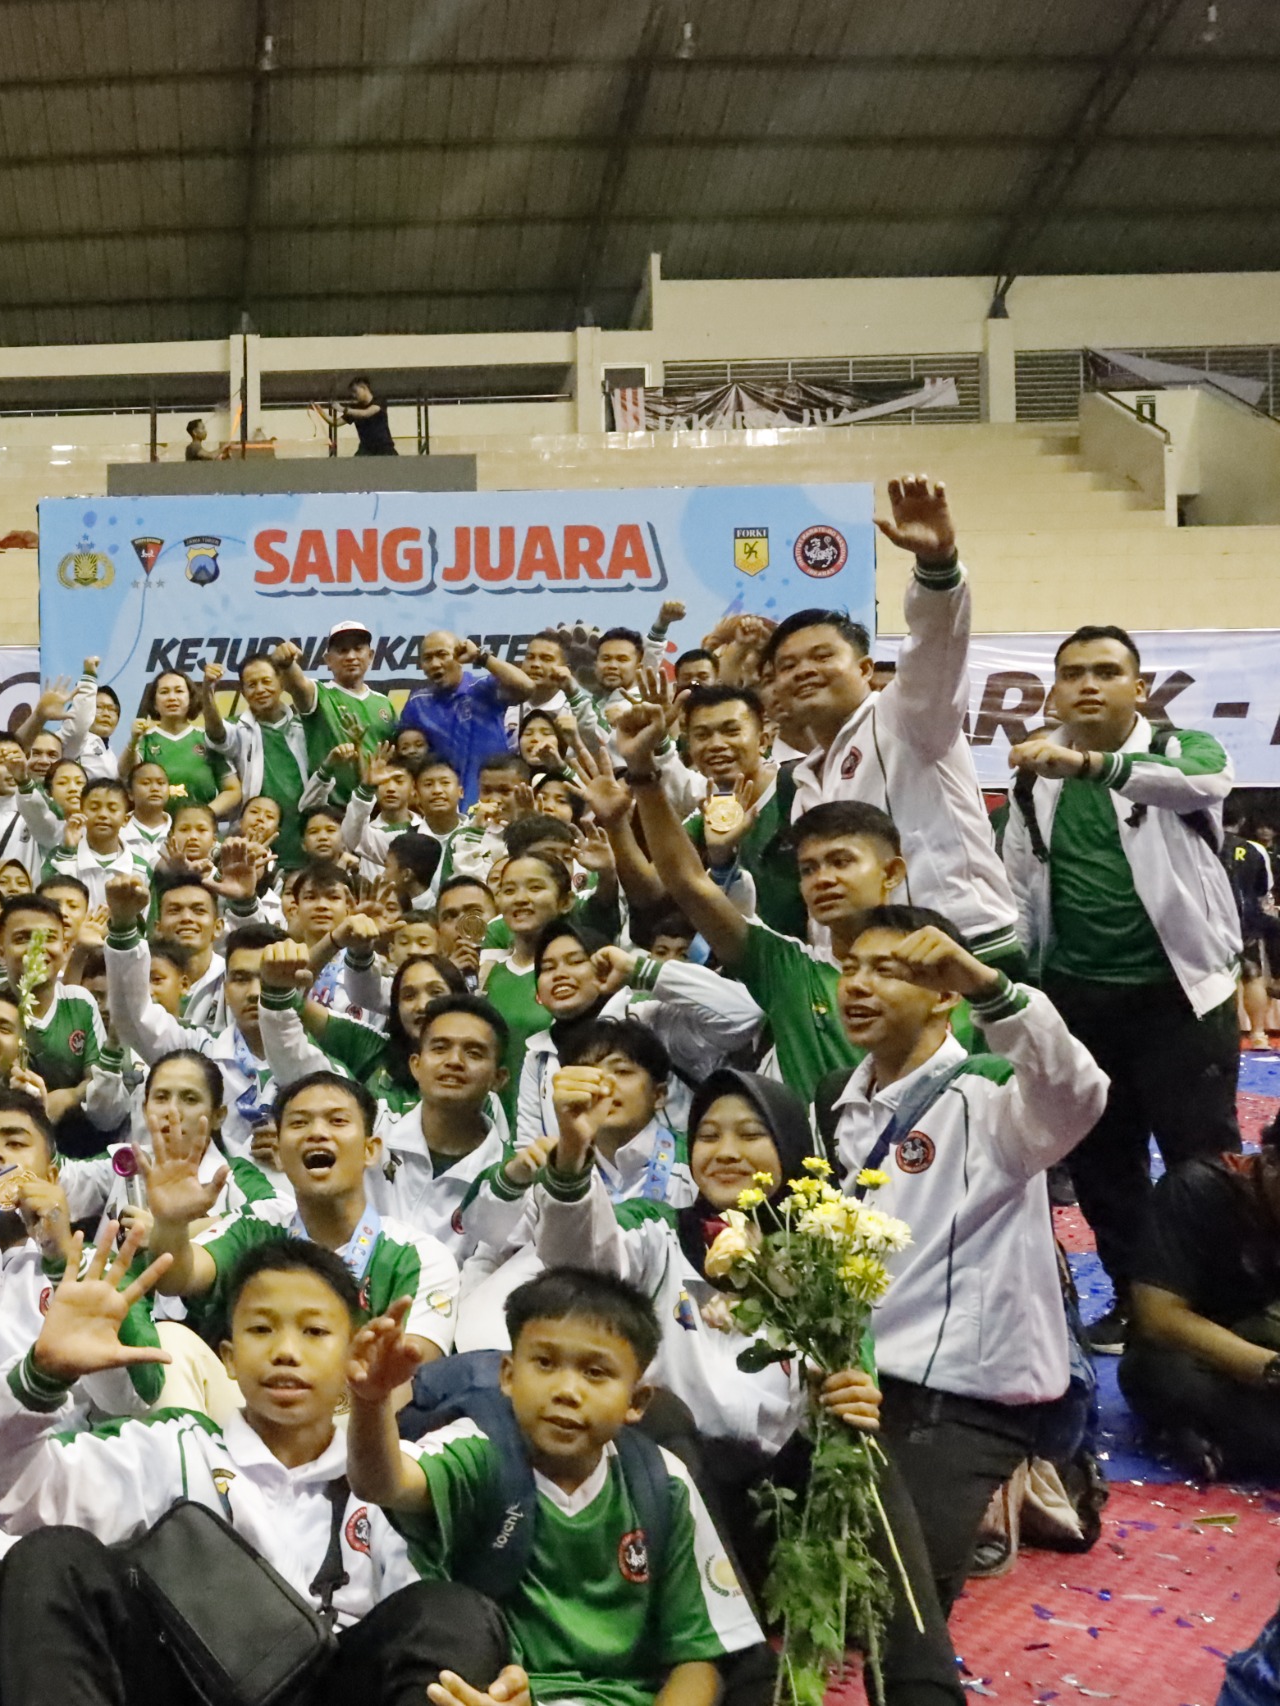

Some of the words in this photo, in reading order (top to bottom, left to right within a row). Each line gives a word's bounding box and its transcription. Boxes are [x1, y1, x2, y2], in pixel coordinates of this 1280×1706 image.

[736, 529, 767, 537] FORKI
[254, 526, 424, 585] SANG
[442, 524, 652, 582] JUARA
[145, 637, 333, 673] KEJUNA
[371, 634, 538, 671] KATE
